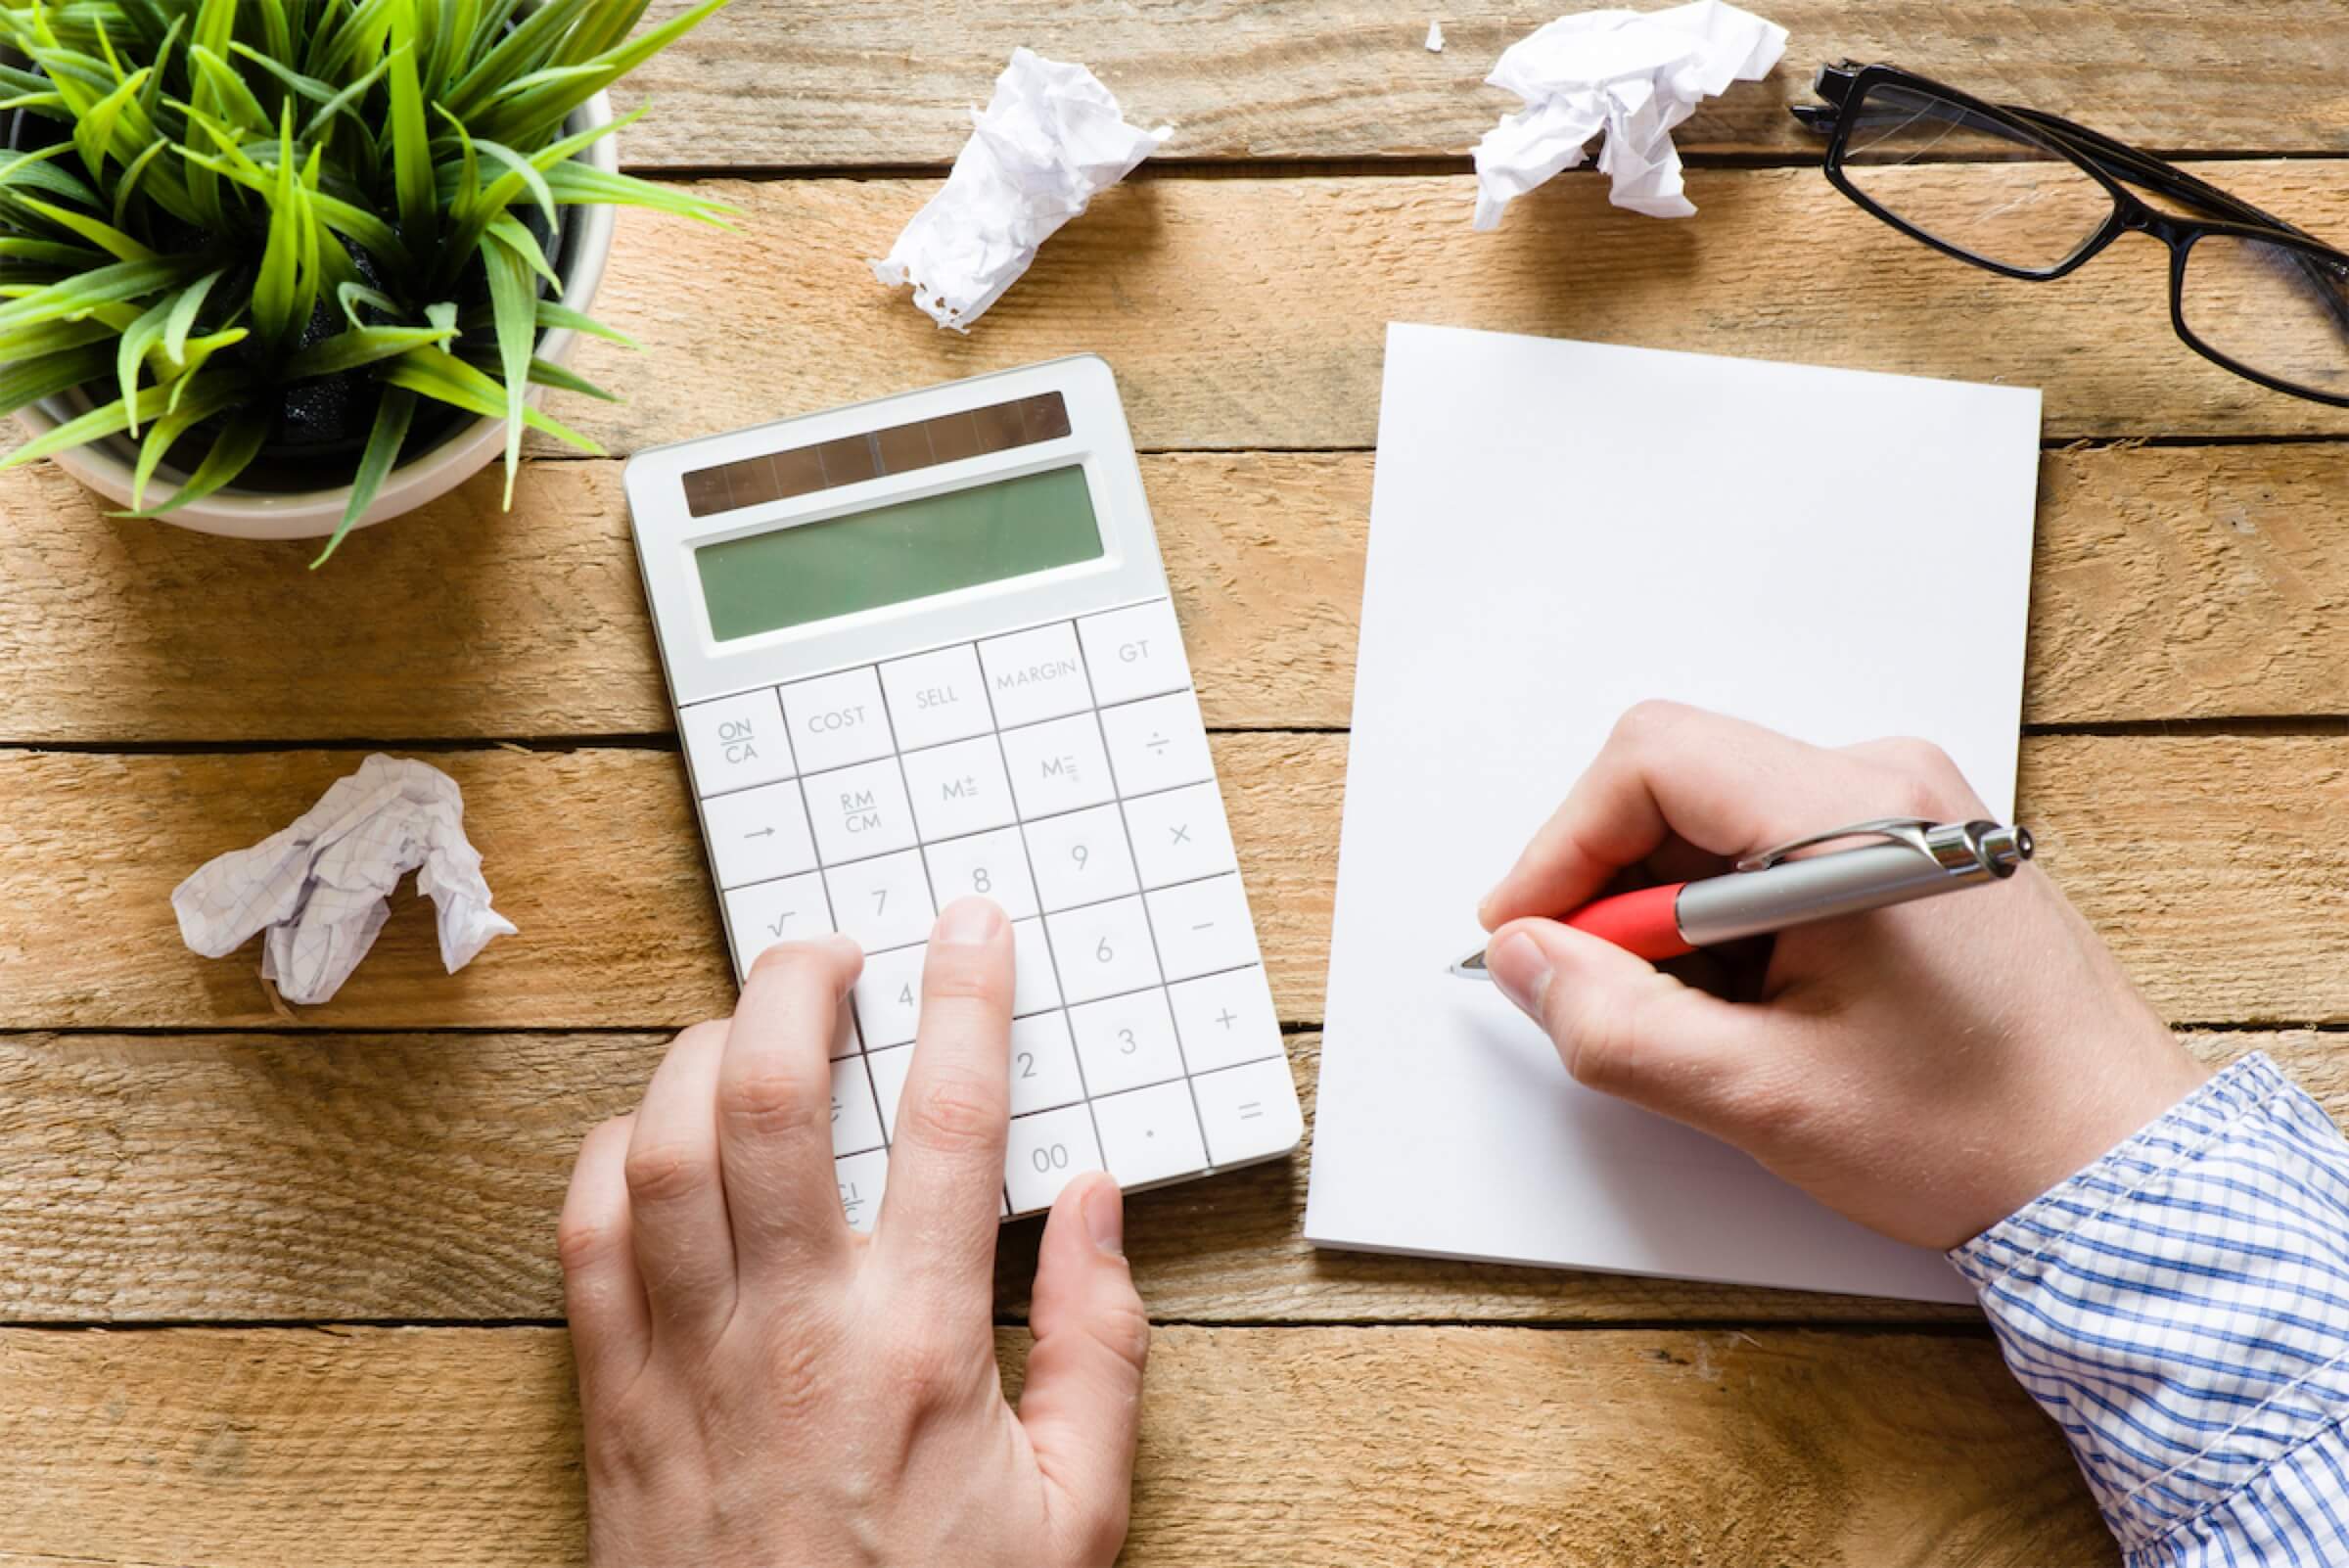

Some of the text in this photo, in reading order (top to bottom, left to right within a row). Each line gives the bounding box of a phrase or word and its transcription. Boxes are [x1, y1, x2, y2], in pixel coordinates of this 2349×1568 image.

[1119, 639, 1150, 664] GT
[996, 658, 1078, 690] MARGIN
[915, 685, 960, 710] SELL
[717, 717, 754, 740] ON
[807, 705, 866, 734] COST
[724, 743, 760, 765] CA
[840, 789, 876, 811] RM
[844, 813, 882, 834] CM
[1071, 845, 1090, 871] 9
[972, 866, 992, 895] 8
[870, 888, 888, 917] 7
[1095, 936, 1114, 964] 6
[898, 982, 915, 1008] 4
[1117, 1028, 1137, 1056] 3
[1016, 1050, 1037, 1080] 2
[1031, 1142, 1070, 1175] 00
